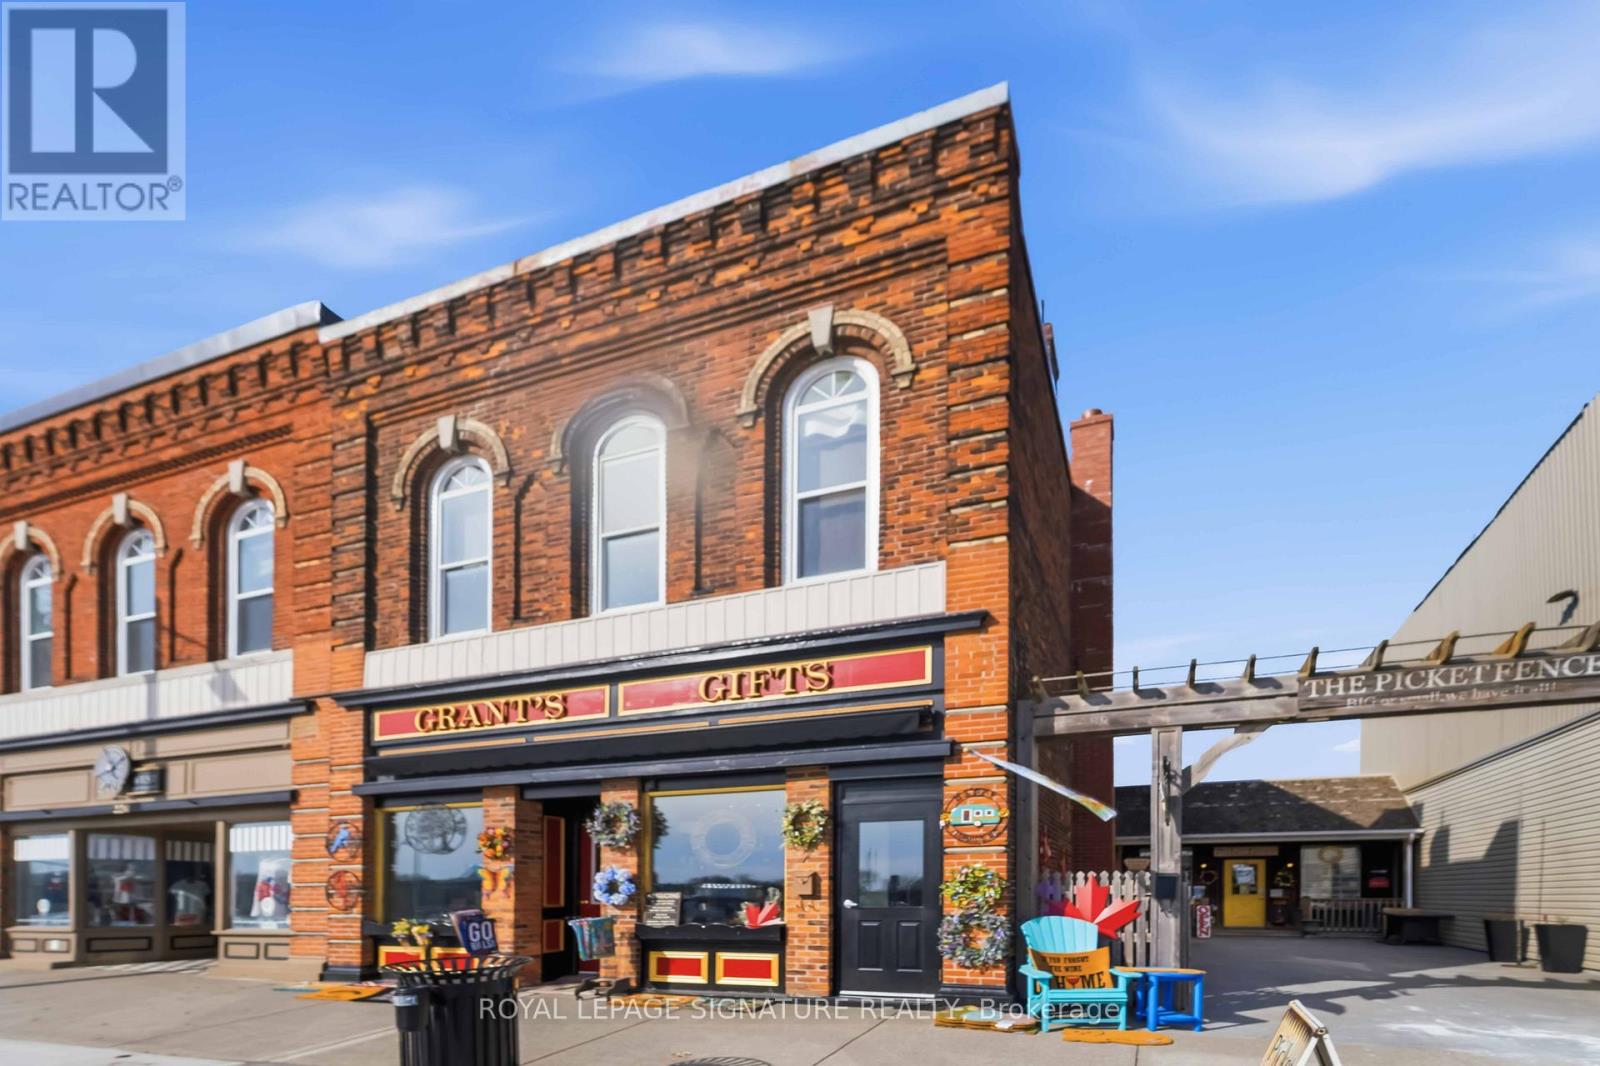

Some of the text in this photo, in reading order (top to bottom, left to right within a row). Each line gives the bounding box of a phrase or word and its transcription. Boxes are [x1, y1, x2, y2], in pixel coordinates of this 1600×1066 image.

[698, 661, 833, 703] GIFTS
[1304, 654, 1600, 698] THE PICKET FENCE
[414, 693, 567, 733] GRANT'S
[469, 921, 493, 942] GO
